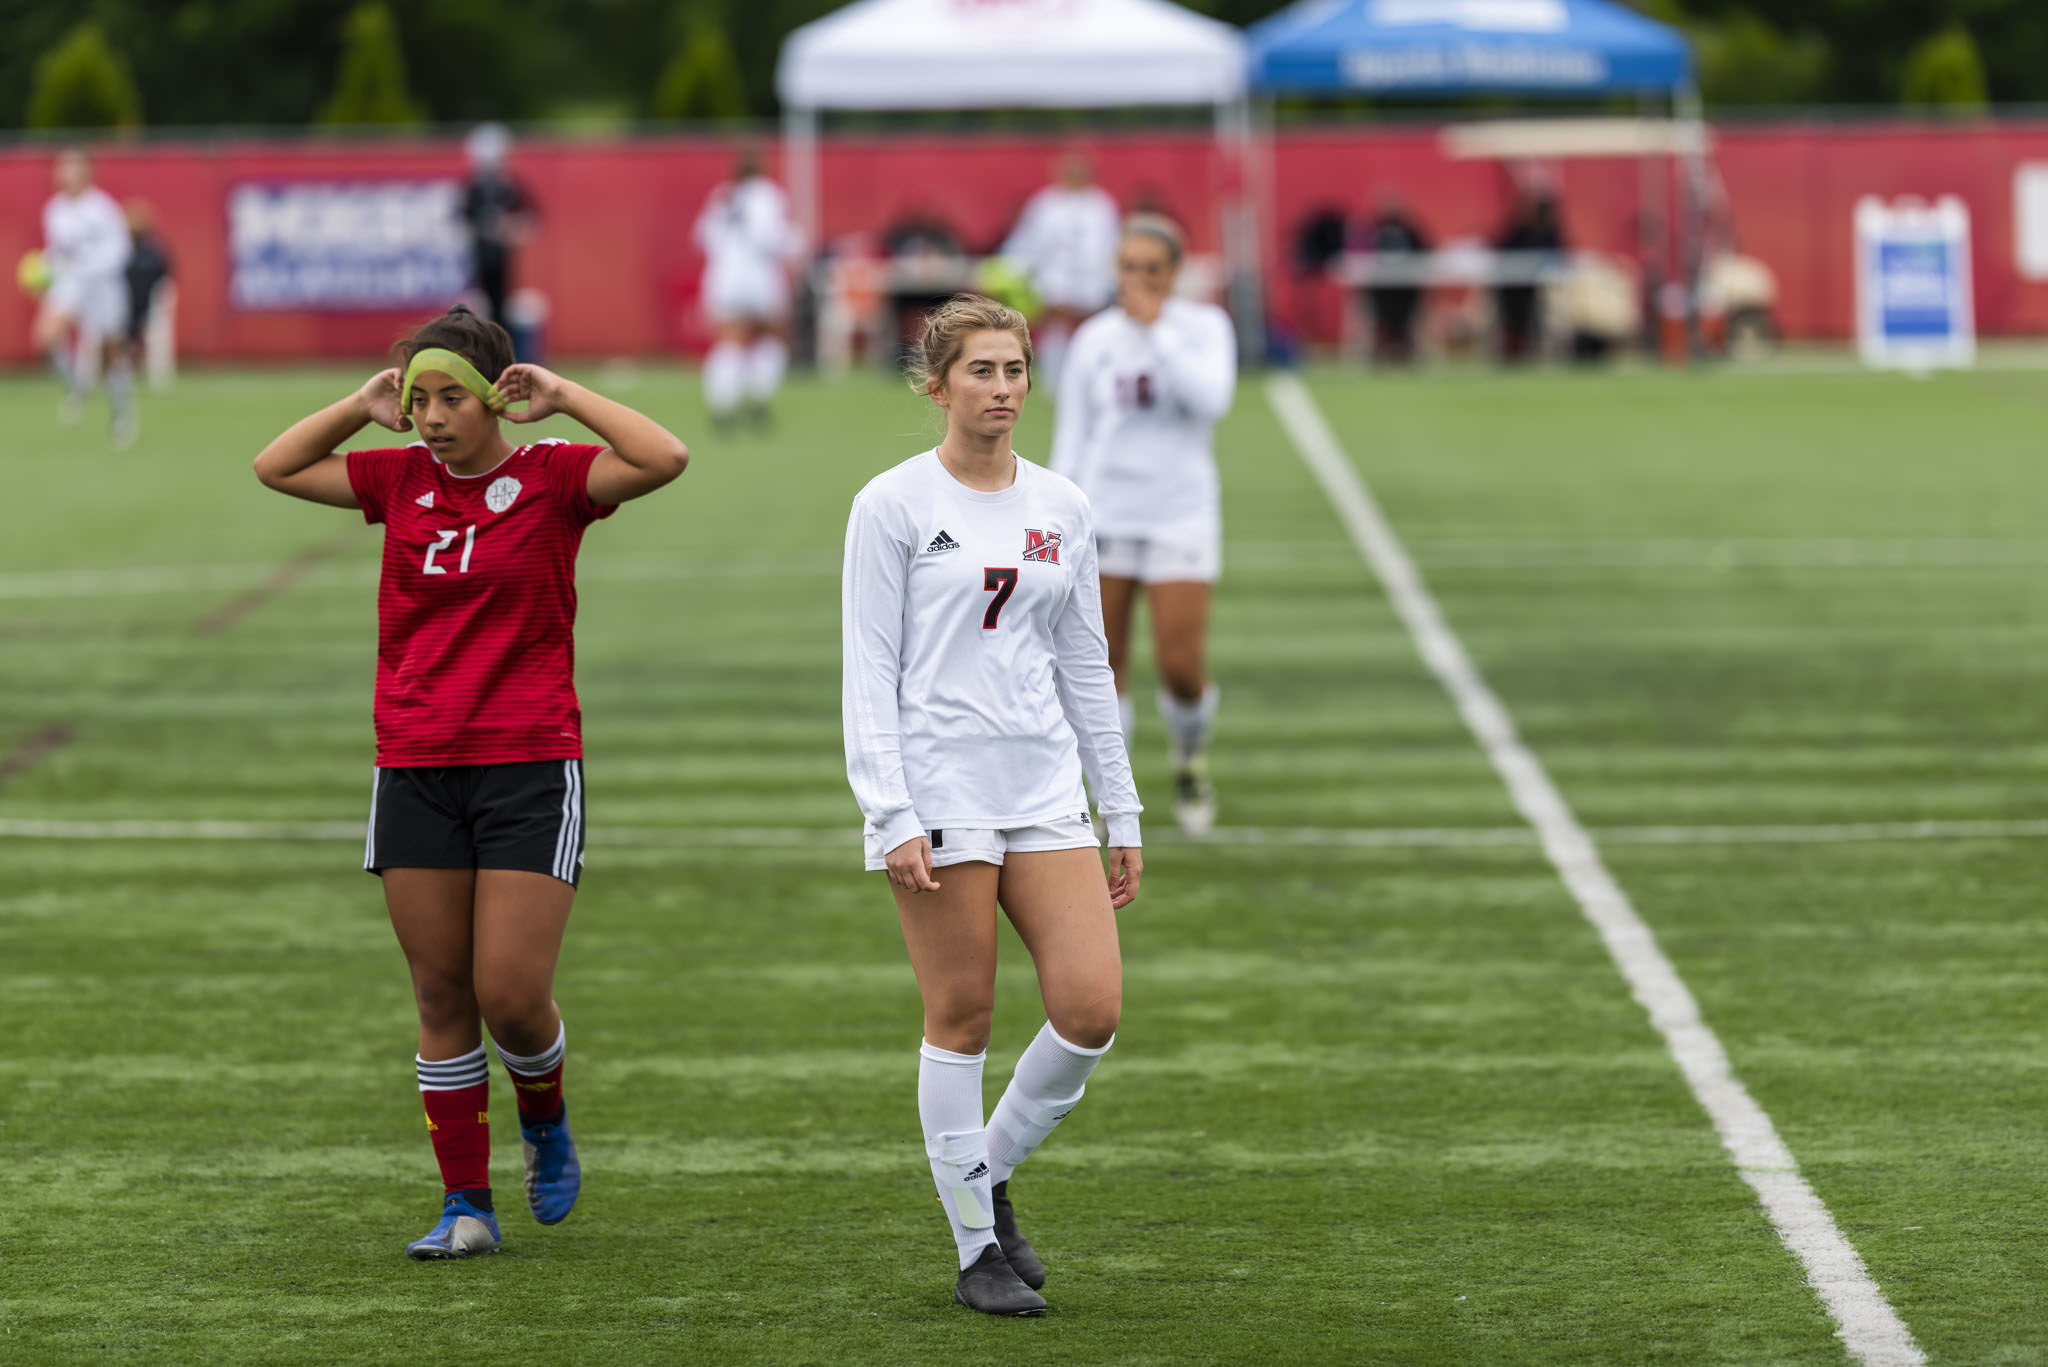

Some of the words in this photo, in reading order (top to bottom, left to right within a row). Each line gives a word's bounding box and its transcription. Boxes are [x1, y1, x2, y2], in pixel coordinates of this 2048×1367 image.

[423, 524, 477, 575] 21
[927, 541, 960, 553] adidas
[982, 567, 1019, 630] 7
